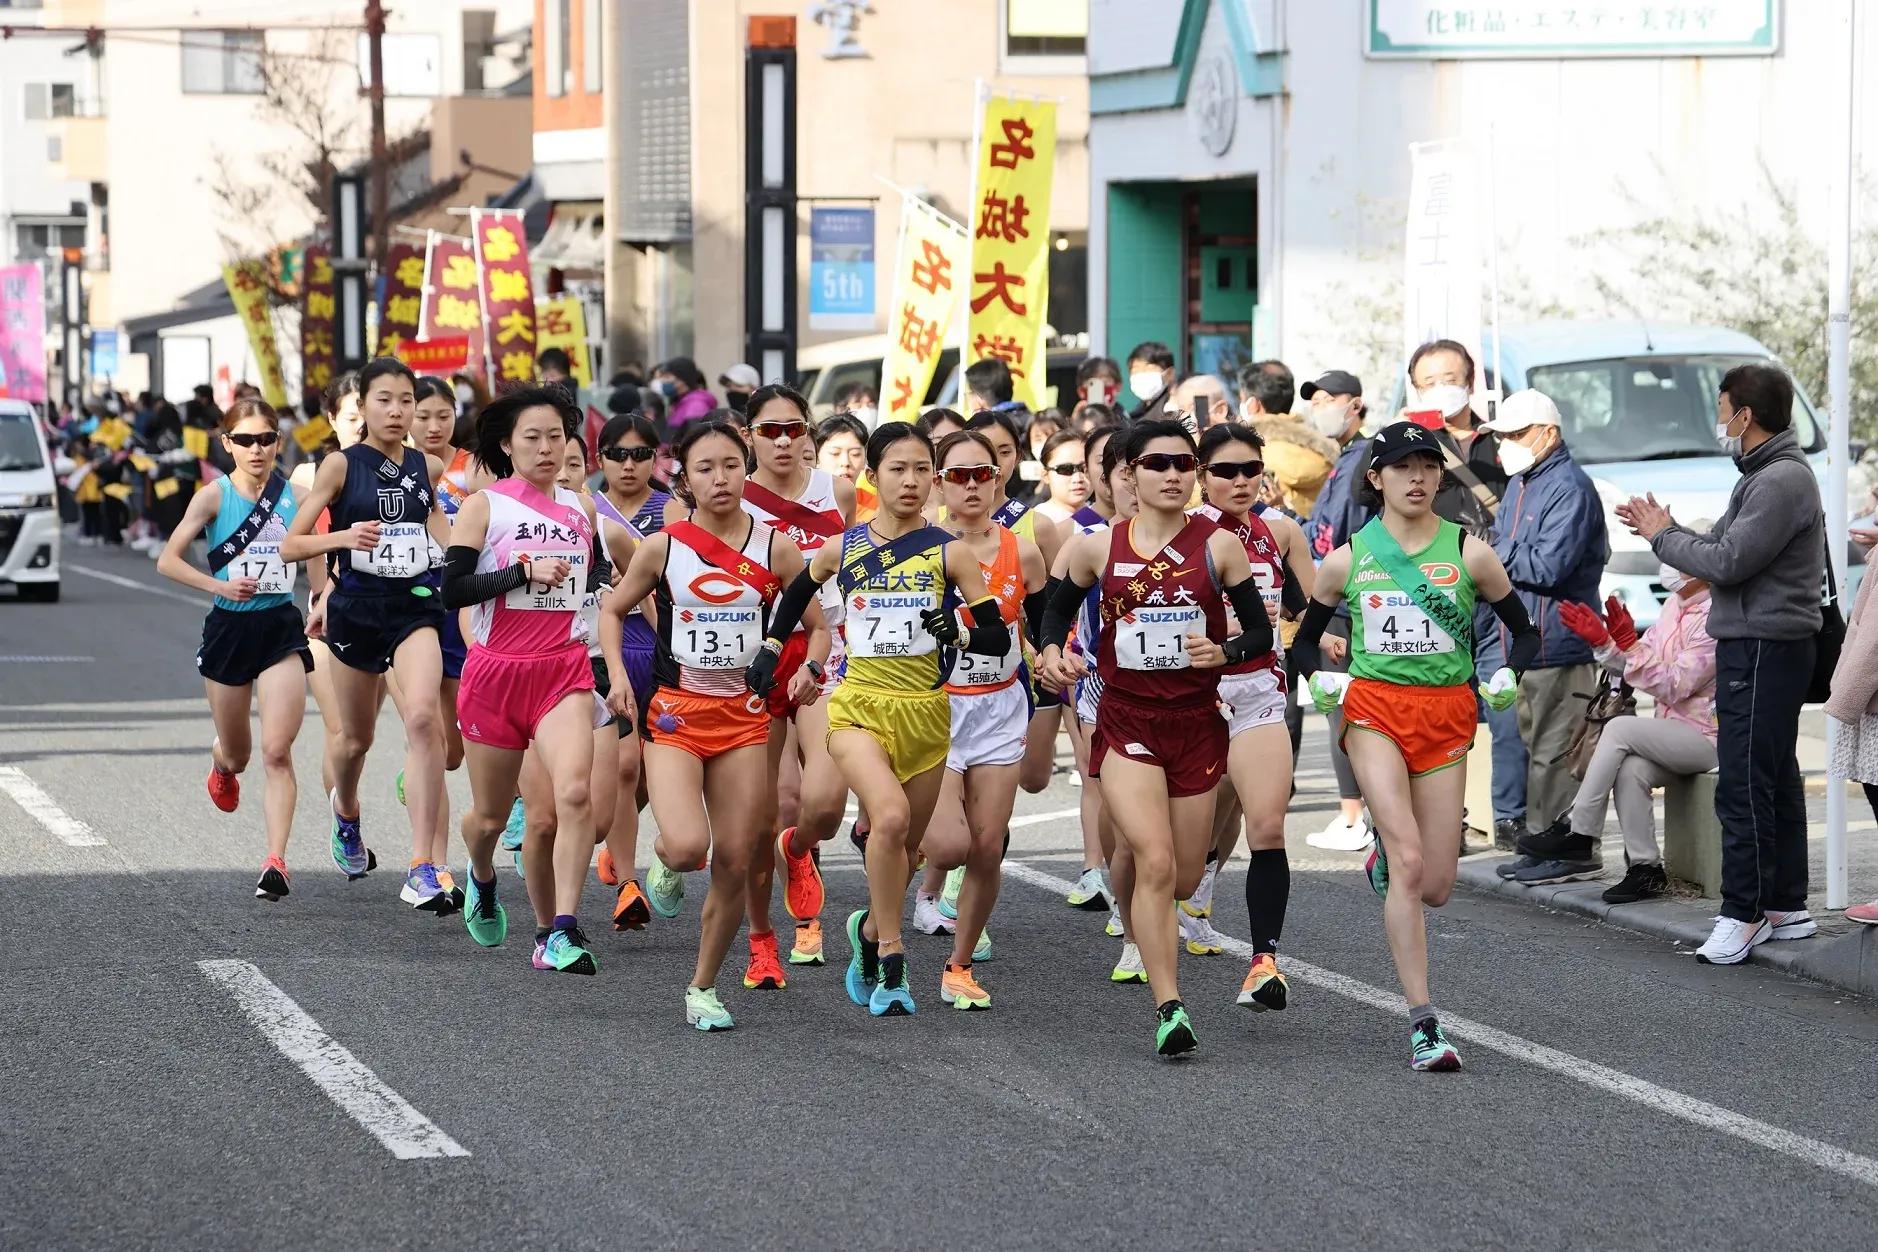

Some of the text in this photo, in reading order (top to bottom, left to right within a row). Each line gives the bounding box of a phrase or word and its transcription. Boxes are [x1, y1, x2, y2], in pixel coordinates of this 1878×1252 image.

[823, 268, 863, 299] 5th
[240, 561, 288, 580] 17-1
[377, 565, 408, 576] 東洋大
[533, 597, 566, 608] 玉川大
[869, 597, 931, 609] SUZUKI
[697, 611, 756, 623] SUZUKI
[1139, 611, 1199, 623] SUZUKI
[687, 629, 746, 654] 13-1
[1380, 640, 1439, 653] 大東文化大
[873, 642, 909, 655] 城西大
[700, 656, 735, 667] 中央大
[1143, 656, 1180, 669] 名城大
[968, 672, 1001, 684] 拓殖大
